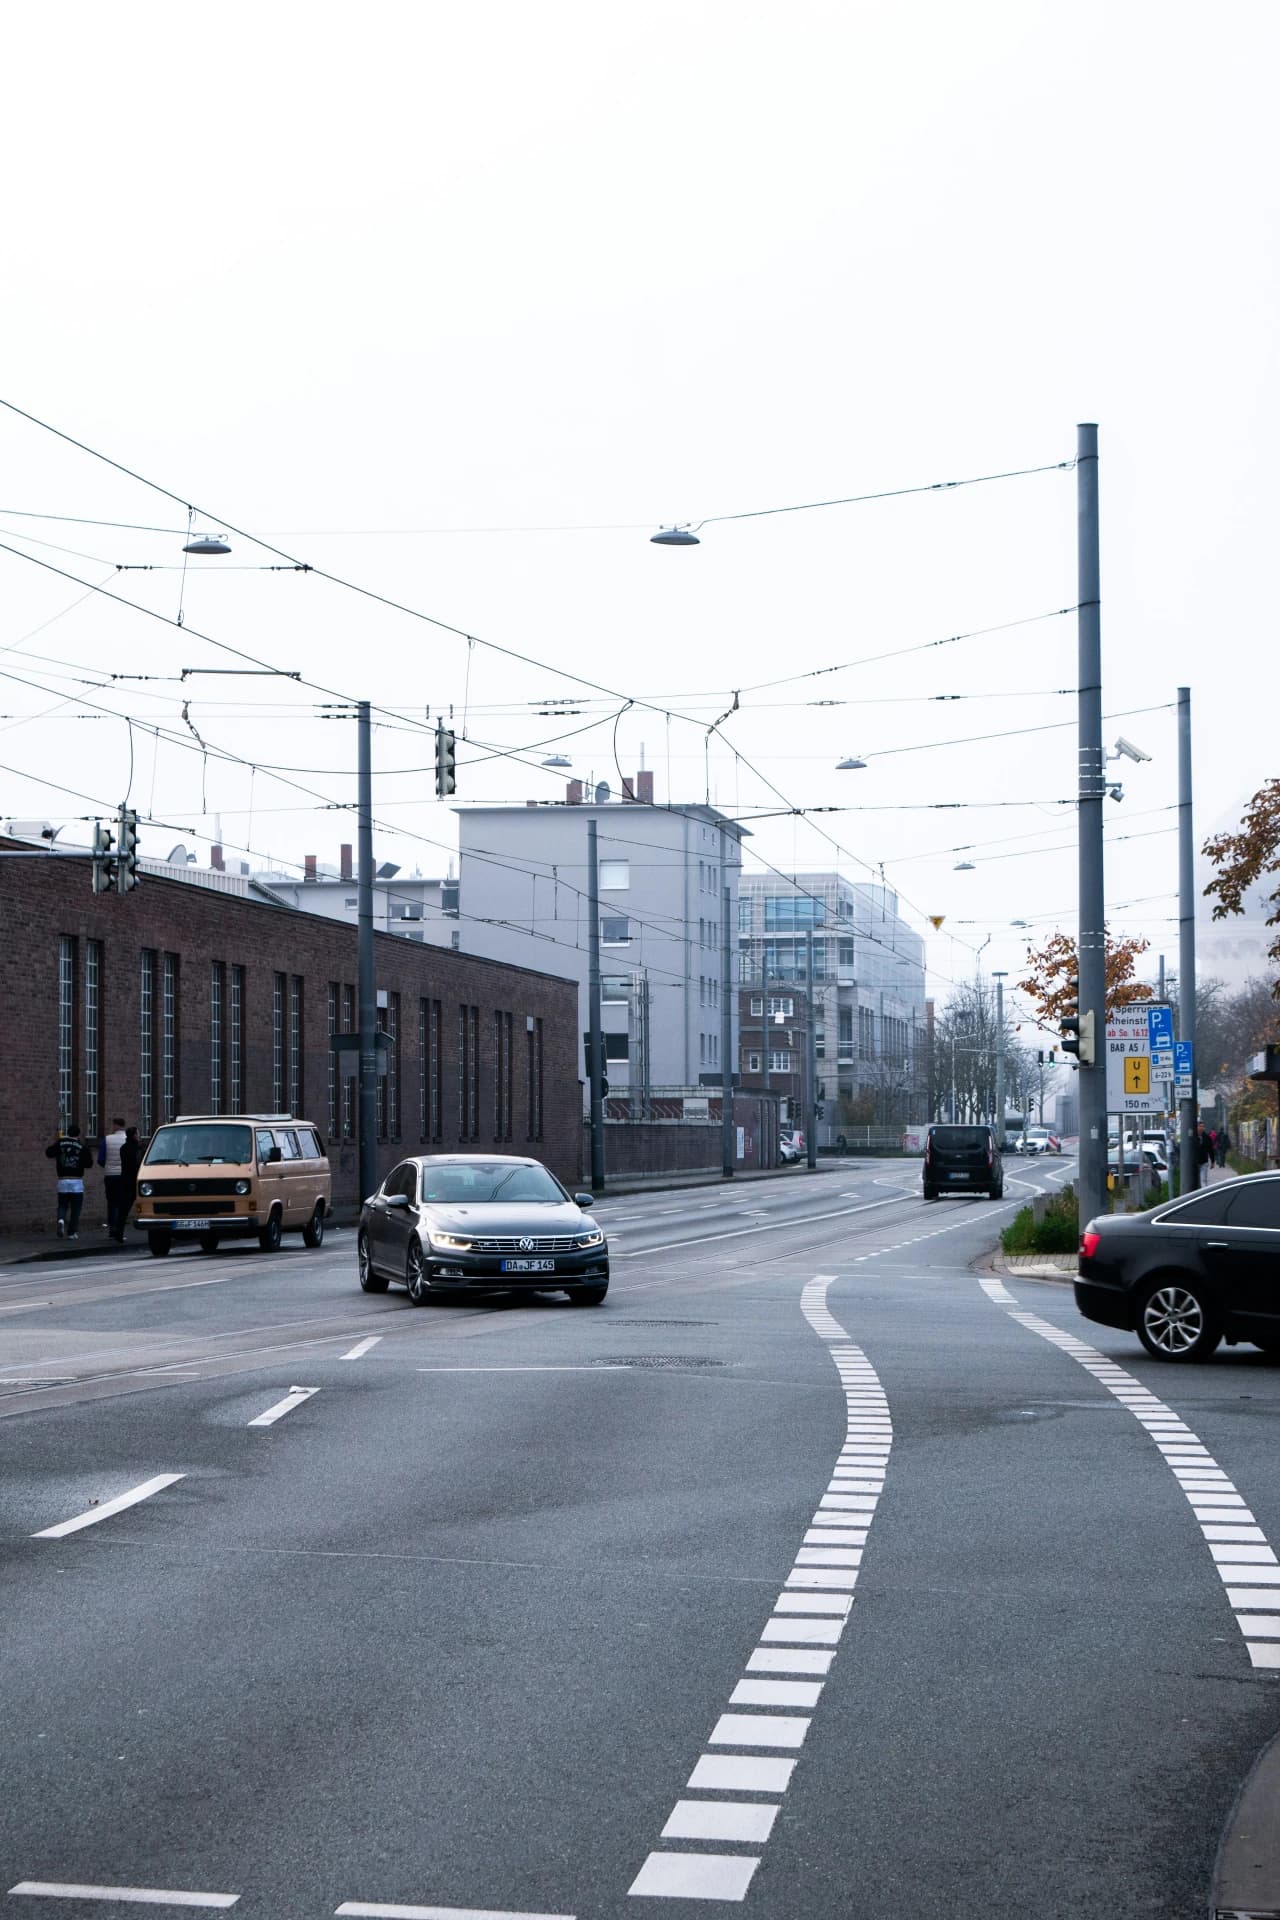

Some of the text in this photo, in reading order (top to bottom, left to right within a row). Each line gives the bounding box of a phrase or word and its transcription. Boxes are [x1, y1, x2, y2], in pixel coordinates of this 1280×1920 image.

[1151, 1012, 1162, 1029] P
[1107, 1028, 1116, 1037] ab
[1110, 1043, 1125, 1053] BAB
[1128, 1043, 1139, 1053] A5
[1176, 1044, 1184, 1057] P
[1133, 1061, 1141, 1070] U
[1125, 1100, 1139, 1109] 150
[506, 1260, 554, 1270] DA JF 145
